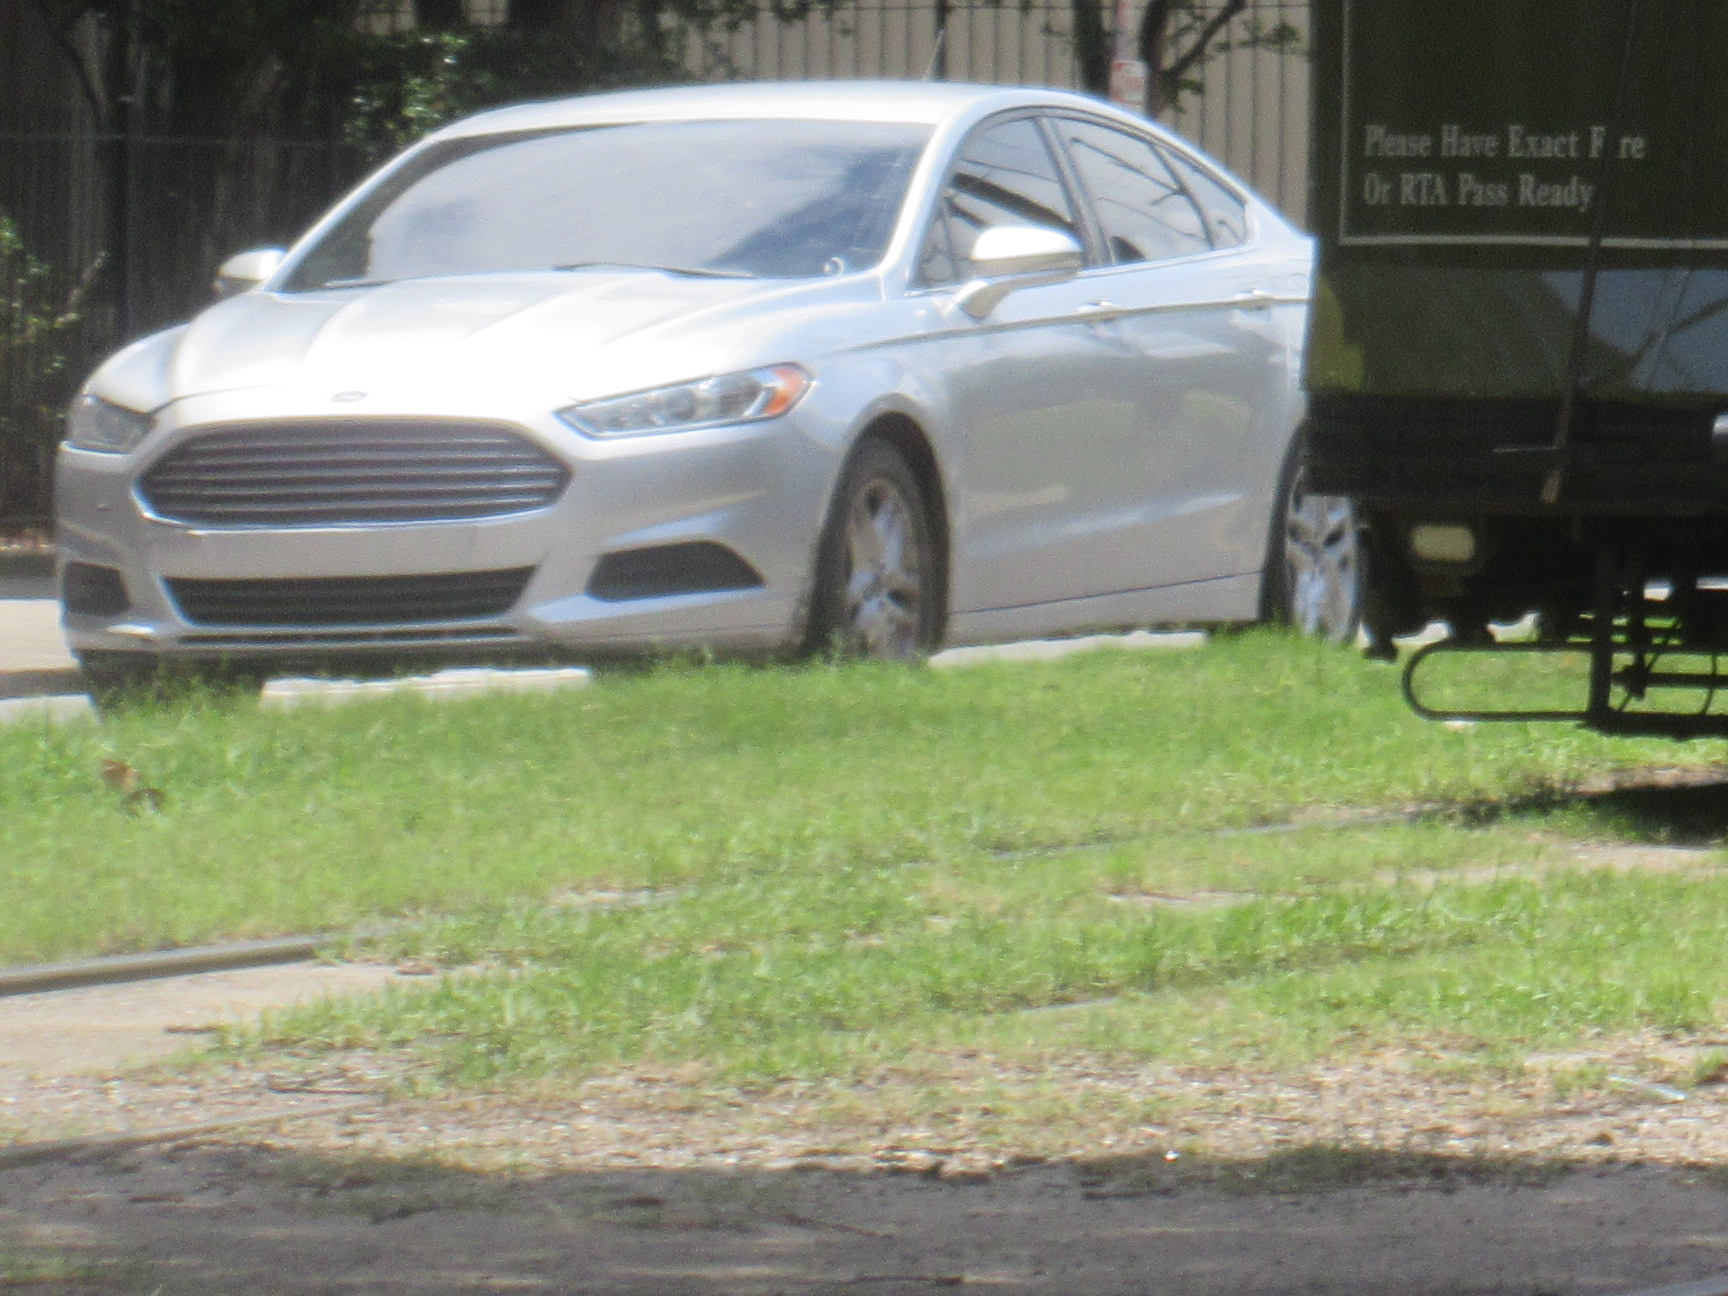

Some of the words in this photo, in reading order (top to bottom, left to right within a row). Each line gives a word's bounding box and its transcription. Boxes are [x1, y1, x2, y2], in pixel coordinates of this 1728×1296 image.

[1363, 124, 1432, 158] Please
[1441, 124, 1498, 158] Have
[1508, 124, 1580, 158] Exact
[1589, 125, 1648, 159] Fre
[1363, 172, 1391, 205] Or
[1399, 172, 1448, 205] RTA
[1457, 172, 1509, 206] Pass
[1518, 173, 1595, 212] Ready
